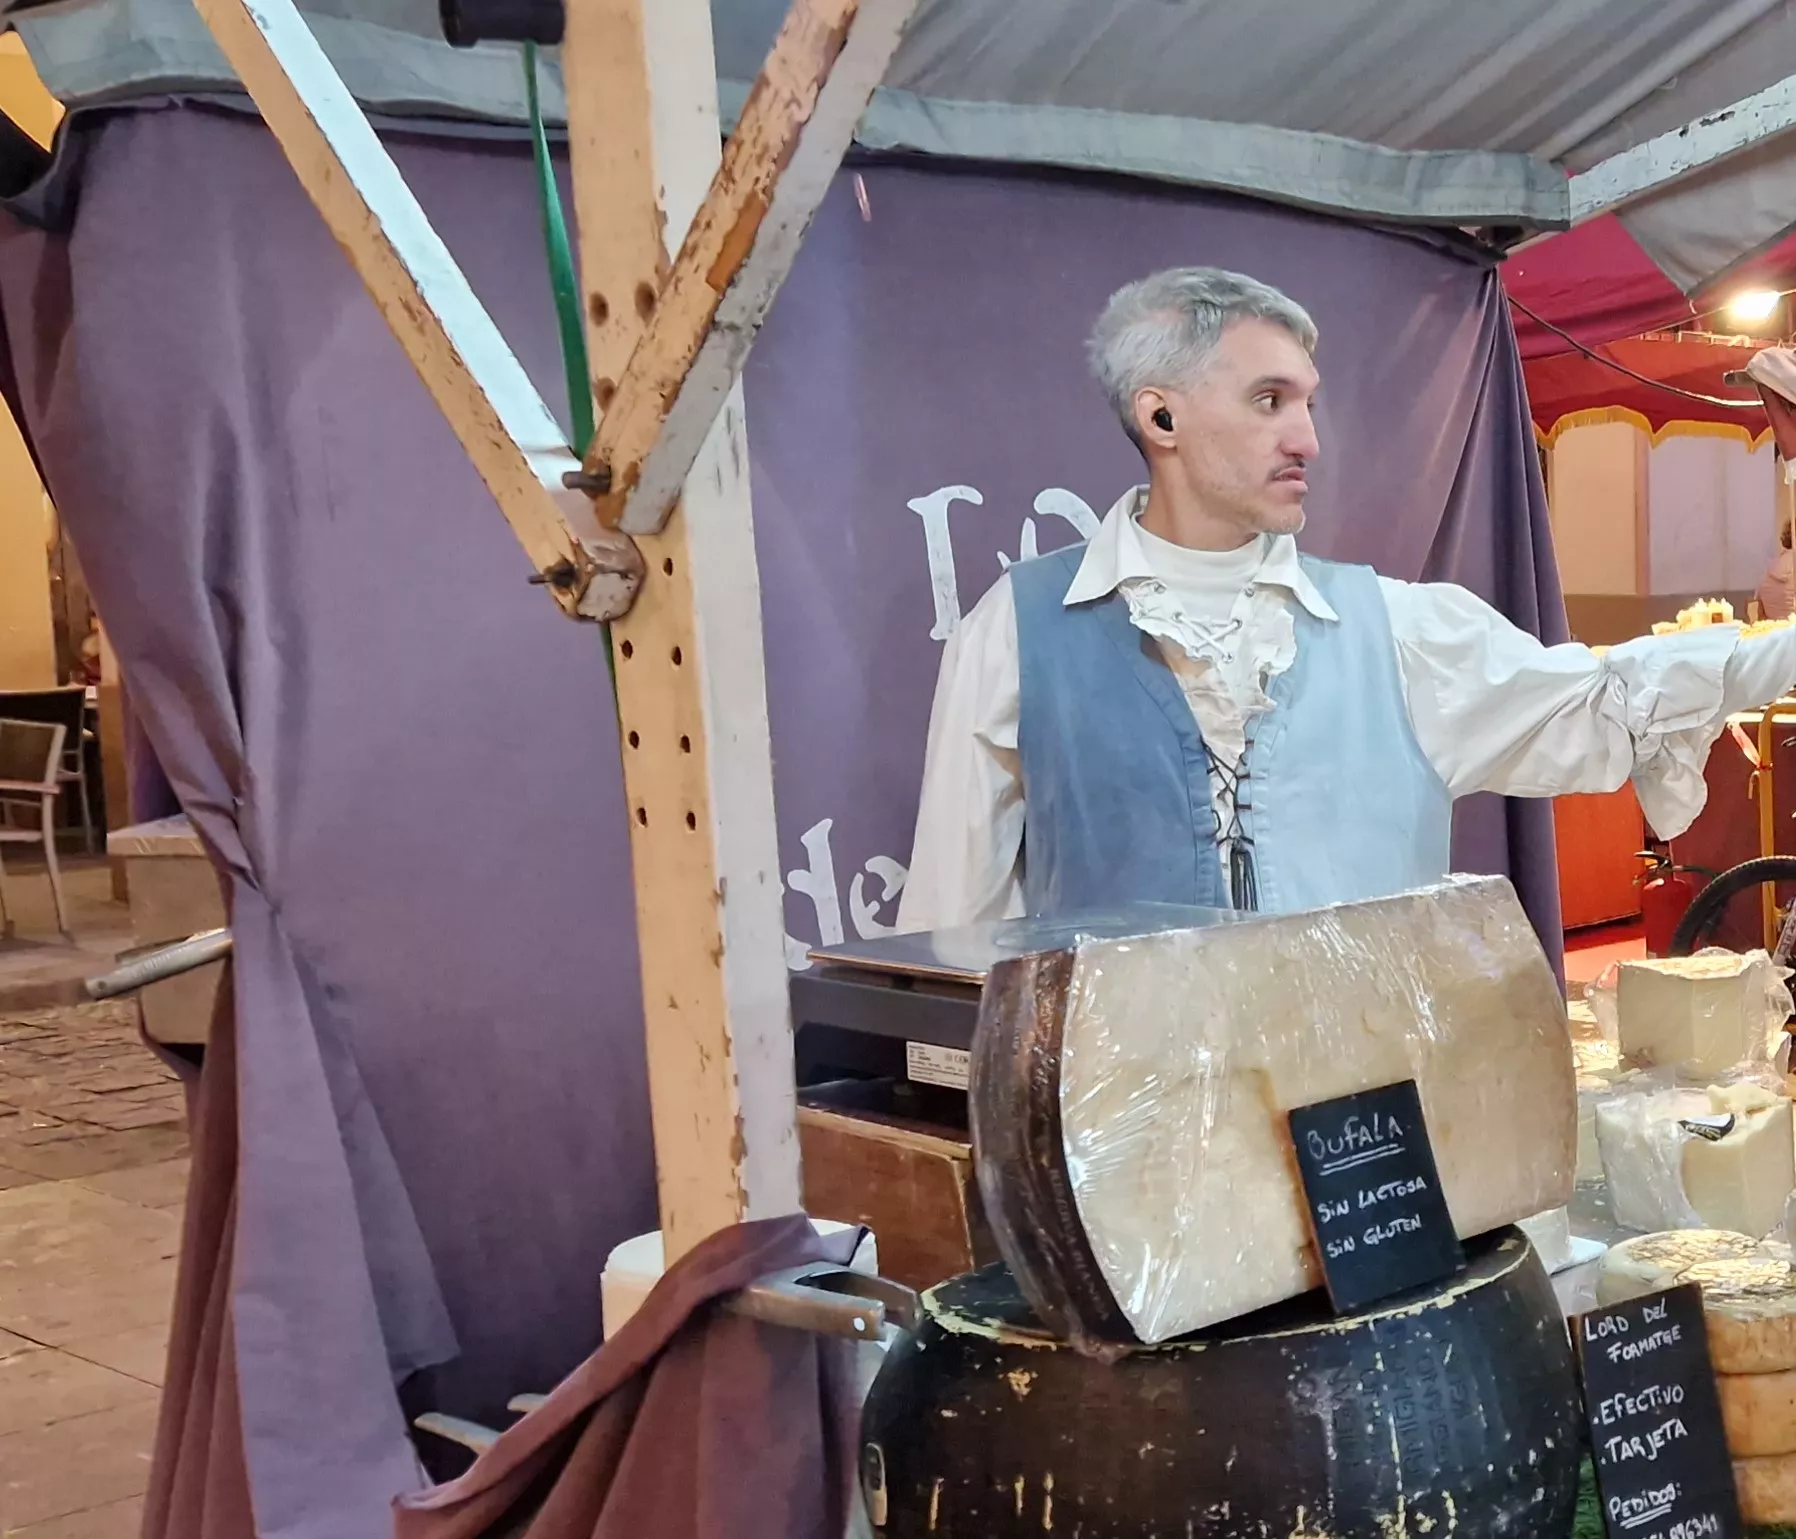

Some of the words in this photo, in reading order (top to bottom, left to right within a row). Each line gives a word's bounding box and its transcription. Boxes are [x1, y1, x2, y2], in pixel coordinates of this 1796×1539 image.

[1363, 1213, 1422, 1246] GLUTEN
[1585, 1315, 1629, 1342] LORD
[1606, 1324, 1682, 1363] FORMATGE
[1604, 1418, 1688, 1463] TARJETA
